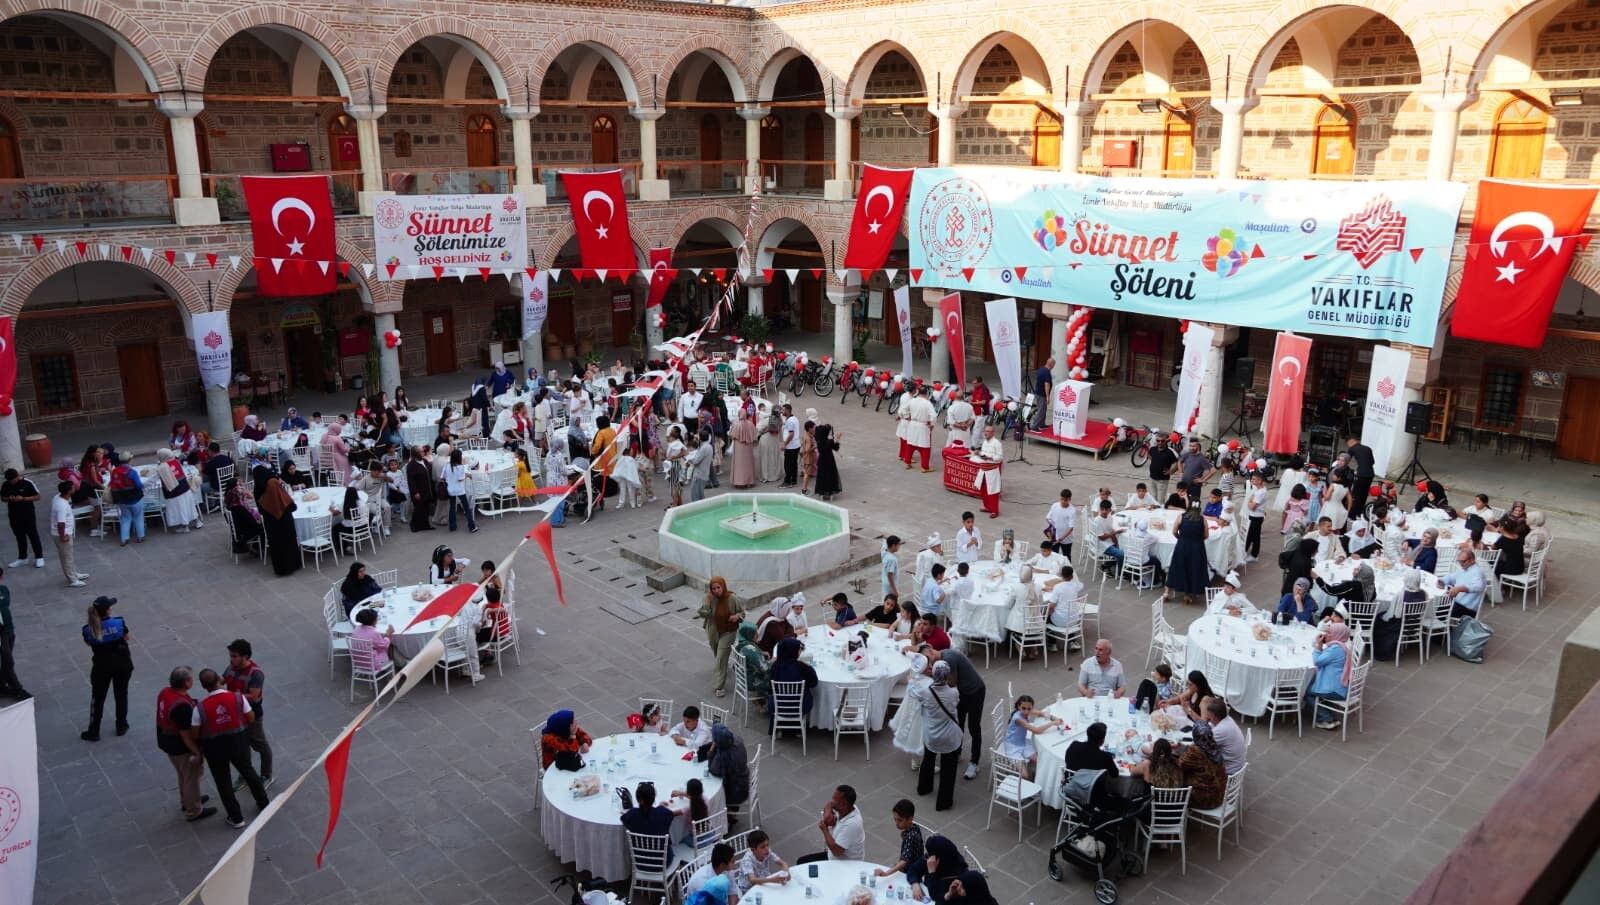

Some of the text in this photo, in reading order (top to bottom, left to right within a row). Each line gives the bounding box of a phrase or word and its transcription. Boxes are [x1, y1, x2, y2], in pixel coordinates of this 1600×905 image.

[406, 211, 494, 237] Sünnet
[1244, 221, 1290, 234] Maşallah
[414, 234, 506, 256] Şölenimize
[1069, 220, 1180, 262] Sünnet
[419, 253, 491, 266] HOŞ GELDİNİZ
[1110, 263, 1196, 301] Şöleni
[1311, 286, 1414, 313] VAKIFLAR
[1308, 310, 1341, 322] GENEL
[2, 839, 32, 855] TURİZM
